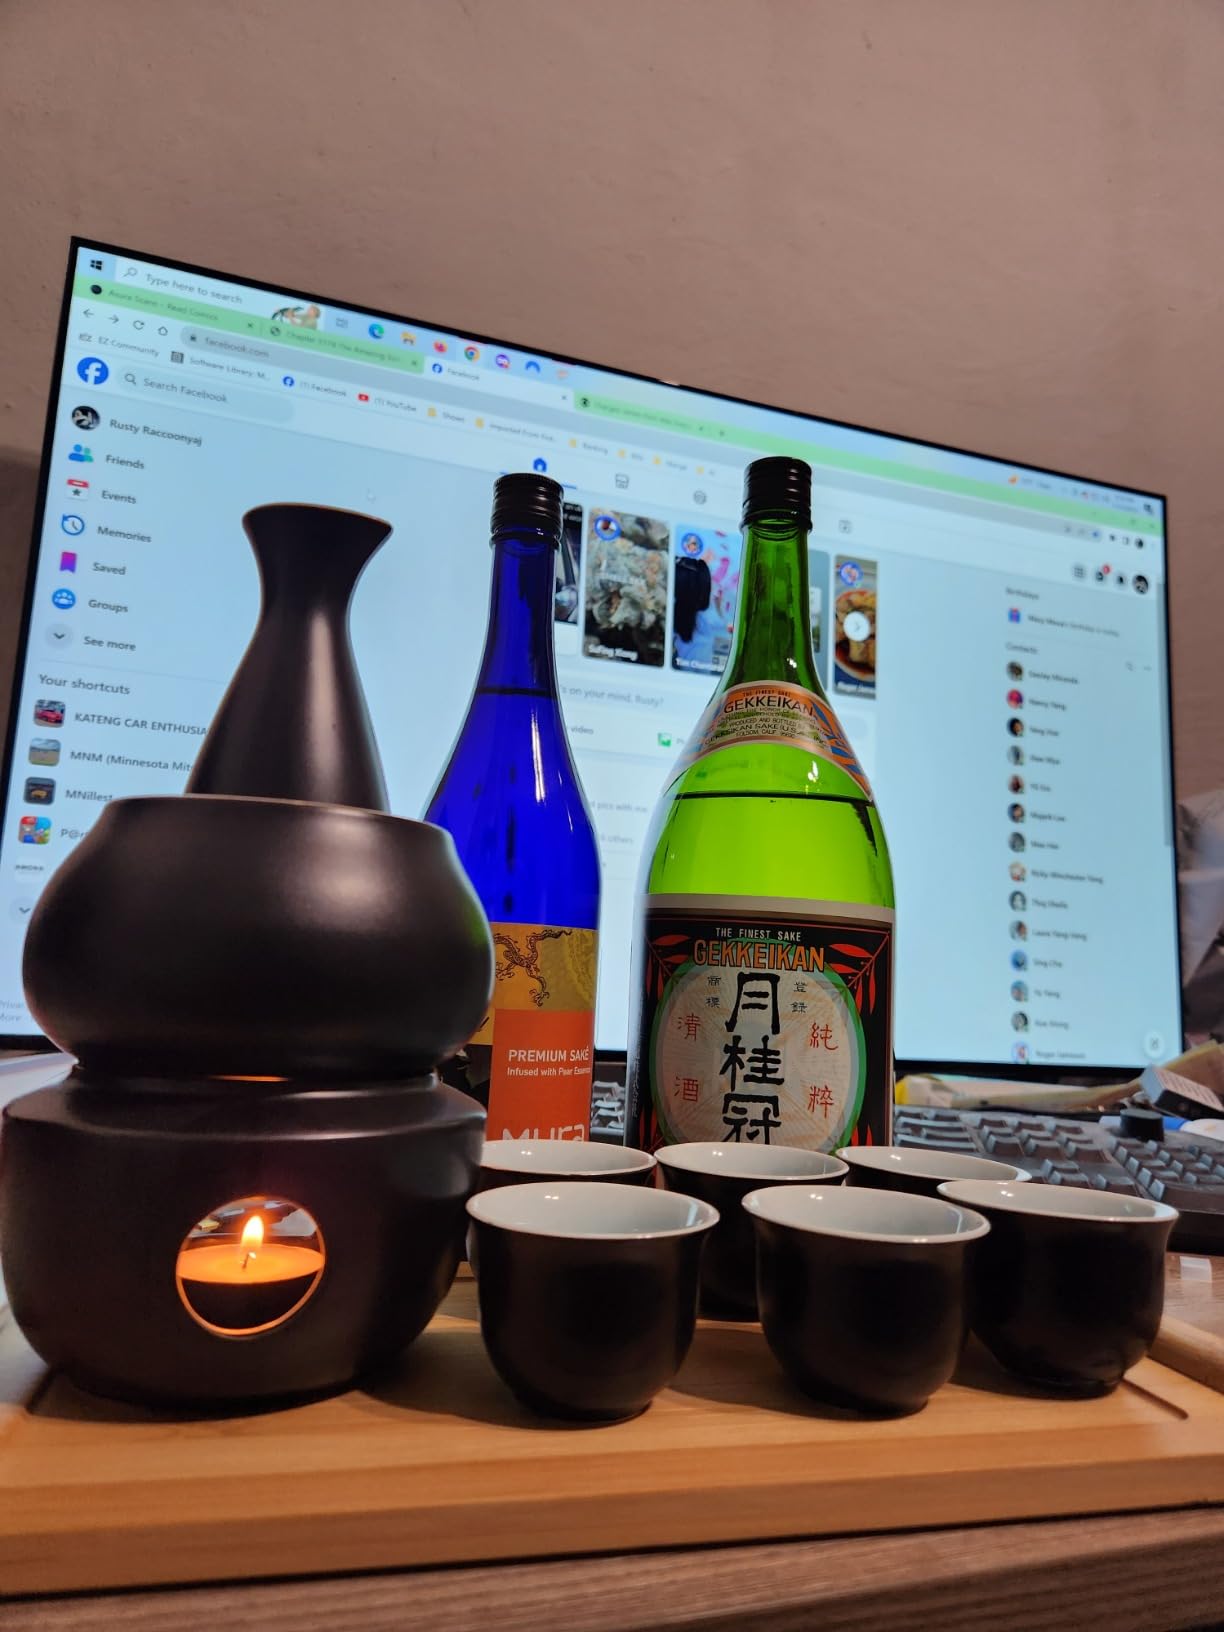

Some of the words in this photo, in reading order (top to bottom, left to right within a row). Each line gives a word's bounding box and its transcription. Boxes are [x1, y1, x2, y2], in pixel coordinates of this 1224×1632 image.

[145, 272, 170, 290] Type
[172, 277, 195, 294] here
[197, 284, 208, 298] to
[210, 288, 243, 304] search
[111, 339, 160, 358] Community
[205, 336, 270, 358] facebook.com
[190, 356, 225, 371] Software
[142, 377, 178, 393] Search
[180, 384, 228, 403] Facebook
[386, 400, 417, 412] YouTube
[109, 418, 140, 435] Rusty
[142, 425, 203, 447] Raccoonyaj
[105, 453, 145, 470] Friends
[101, 489, 137, 505] Events
[97, 525, 152, 543] Memories
[92, 561, 127, 576] Saved
[88, 598, 129, 614] Groups
[83, 635, 105, 648] See
[106, 639, 137, 652] more
[39, 673, 68, 688] Your
[71, 677, 131, 696] shortcuts
[569, 687, 583, 697] on
[583, 689, 606, 700] your
[723, 695, 814, 717] GEKKEIKAN
[74, 711, 121, 727] KATENG
[124, 717, 148, 730] CAR
[754, 723, 779, 731] SAKE
[570, 725, 595, 736] video
[70, 750, 103, 763] MNM
[106, 753, 169, 771] (Minnesota
[715, 927, 732, 938] THE
[739, 928, 771, 940] FINEST
[777, 930, 801, 942] SAKE
[693, 939, 825, 973] GEKKEIKAN
[508, 1049, 567, 1062] PREMIUM
[507, 1066, 539, 1076] Infused
[541, 1066, 557, 1076] with
